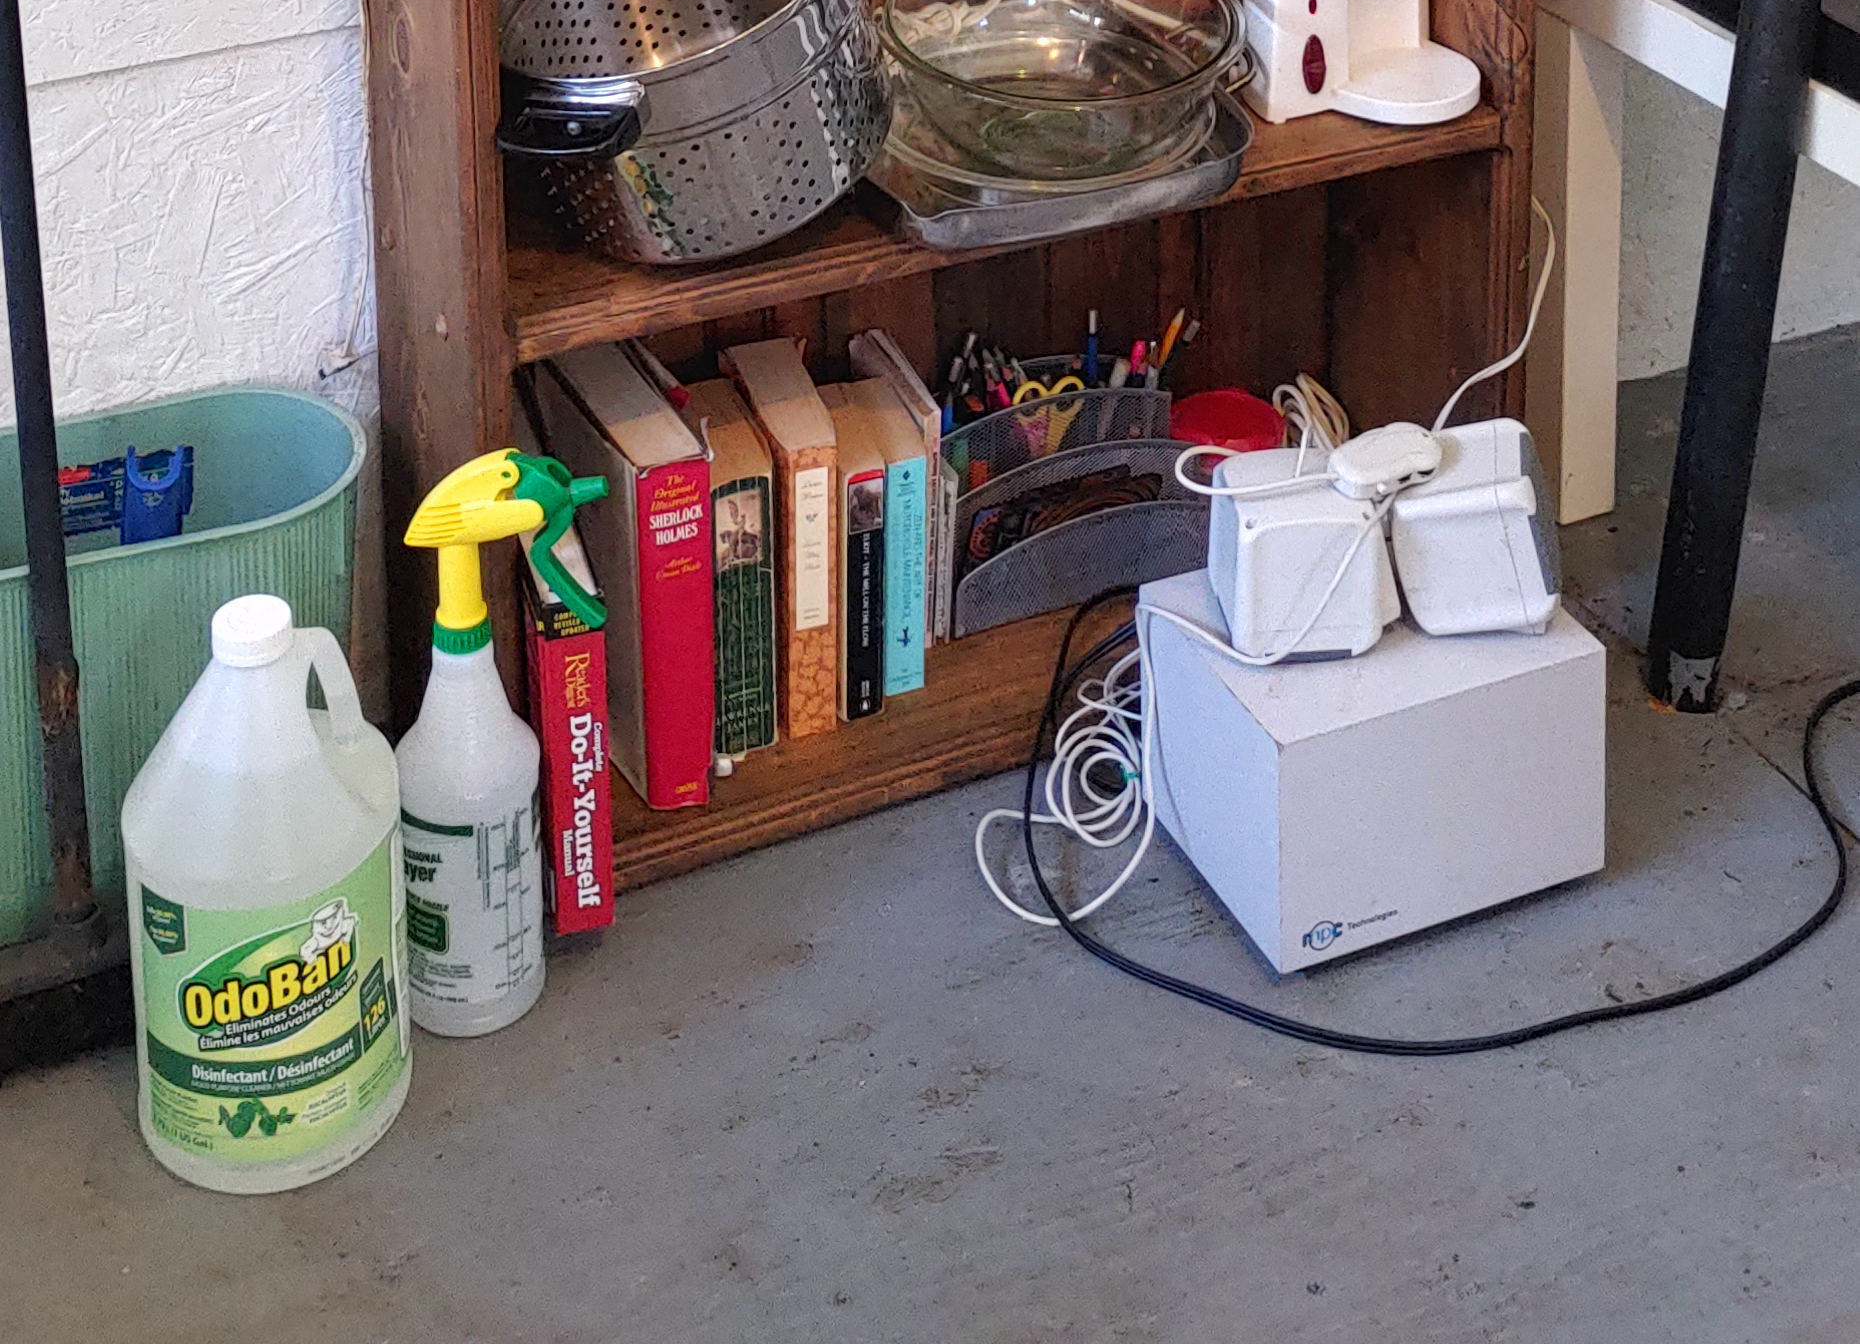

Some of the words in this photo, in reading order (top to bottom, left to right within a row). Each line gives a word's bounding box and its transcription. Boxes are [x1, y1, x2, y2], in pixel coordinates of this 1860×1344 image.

[648, 503, 704, 530] SHERLOCK
[655, 522, 699, 546] HOLMES
[569, 712, 602, 909] Do-It-Yourself
[562, 828, 576, 877] Manual
[185, 940, 351, 1028] OdoBan
[199, 1035, 242, 1051] Élimine
[242, 1029, 260, 1044] les
[261, 1003, 324, 1039] mauvaises
[225, 1010, 288, 1037] Eliminates
[288, 985, 332, 1016] Odours
[363, 995, 386, 1034] 126
[191, 1064, 268, 1084] Disinfectant
[276, 1038, 355, 1081] Désinfectant
